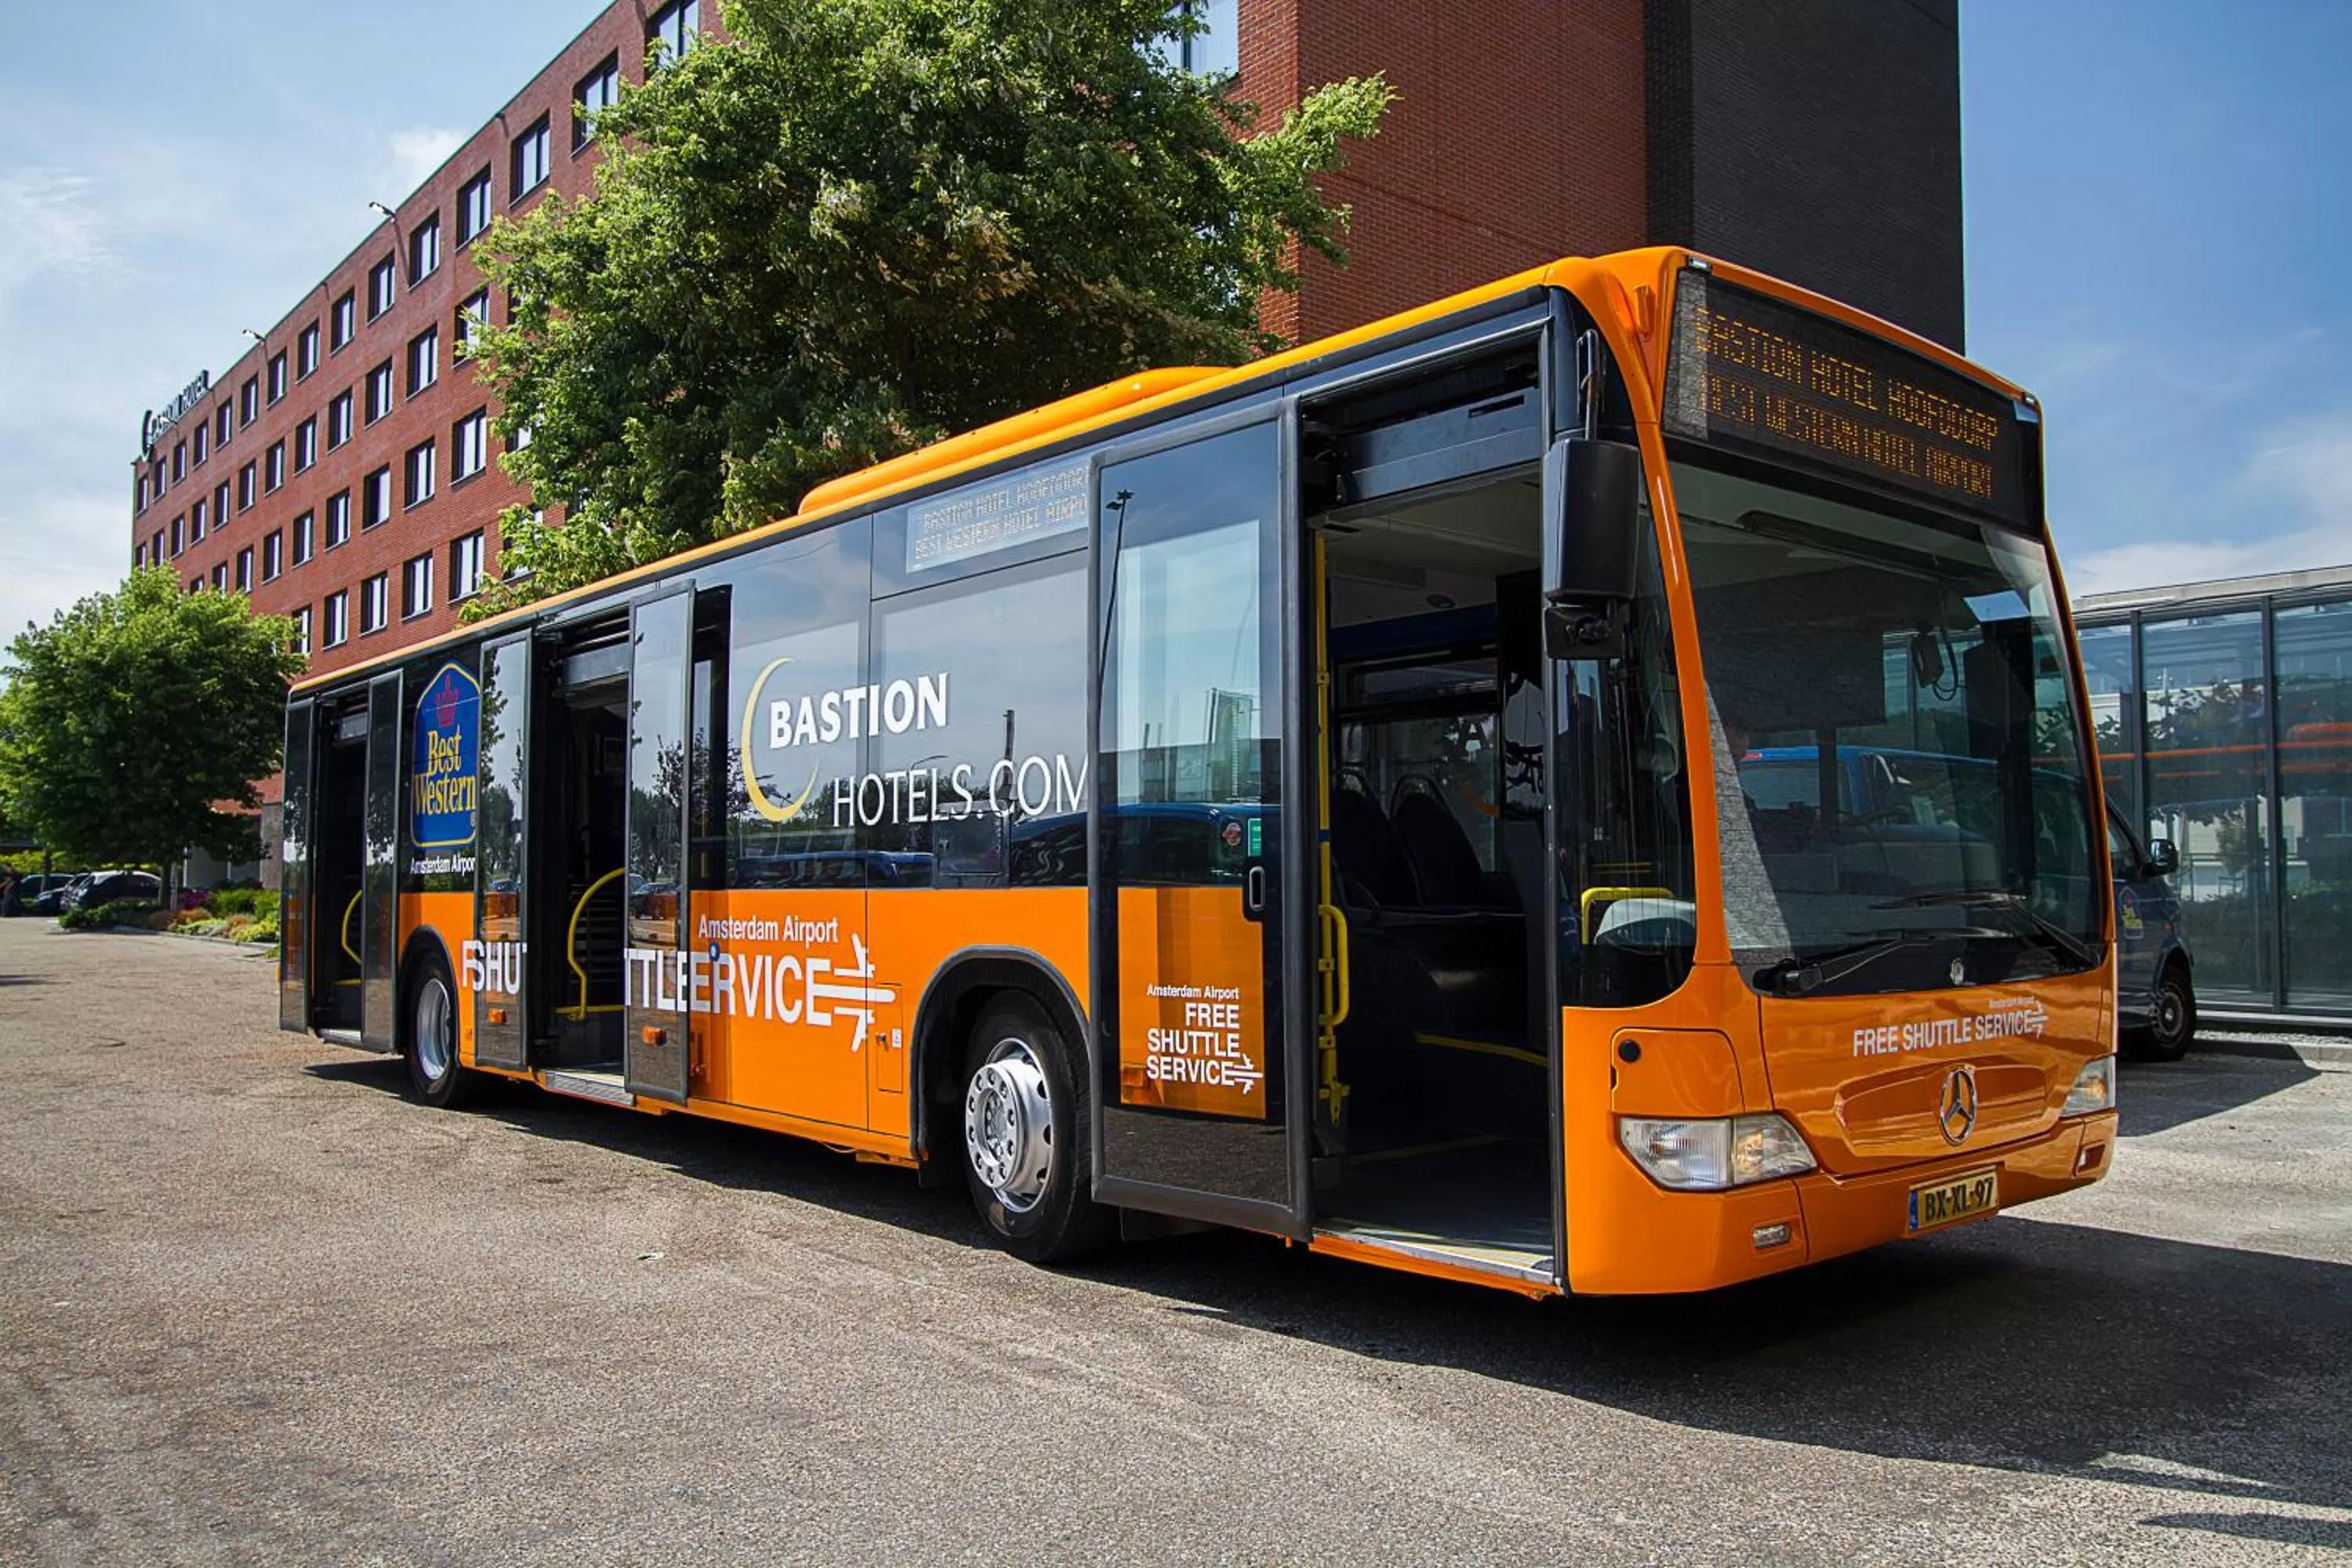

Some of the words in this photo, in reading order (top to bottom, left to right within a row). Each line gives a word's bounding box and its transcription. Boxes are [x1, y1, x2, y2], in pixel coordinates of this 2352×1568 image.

[1812, 350, 1879, 411] HOTEL
[770, 672, 948, 749] BASTION
[427, 724, 462, 776] Best
[413, 773, 477, 815] Western
[833, 753, 1088, 827] HOTELS.COM
[410, 856, 451, 874] Amsterdam
[452, 852, 476, 877] Airpor
[699, 914, 778, 942] Amsterdam
[782, 914, 838, 949] Airport
[1147, 983, 1202, 999] Amsterdam
[1203, 985, 1240, 1001] Airport
[1185, 1003, 1240, 1029] FREE
[1853, 1026, 1899, 1057] FREE
[1903, 1017, 1972, 1052] SHUTTLE
[1975, 1009, 2032, 1041] SERVICE
[1147, 1028, 1241, 1058] SHUTTLE
[1146, 1055, 1236, 1087] SERVICE
